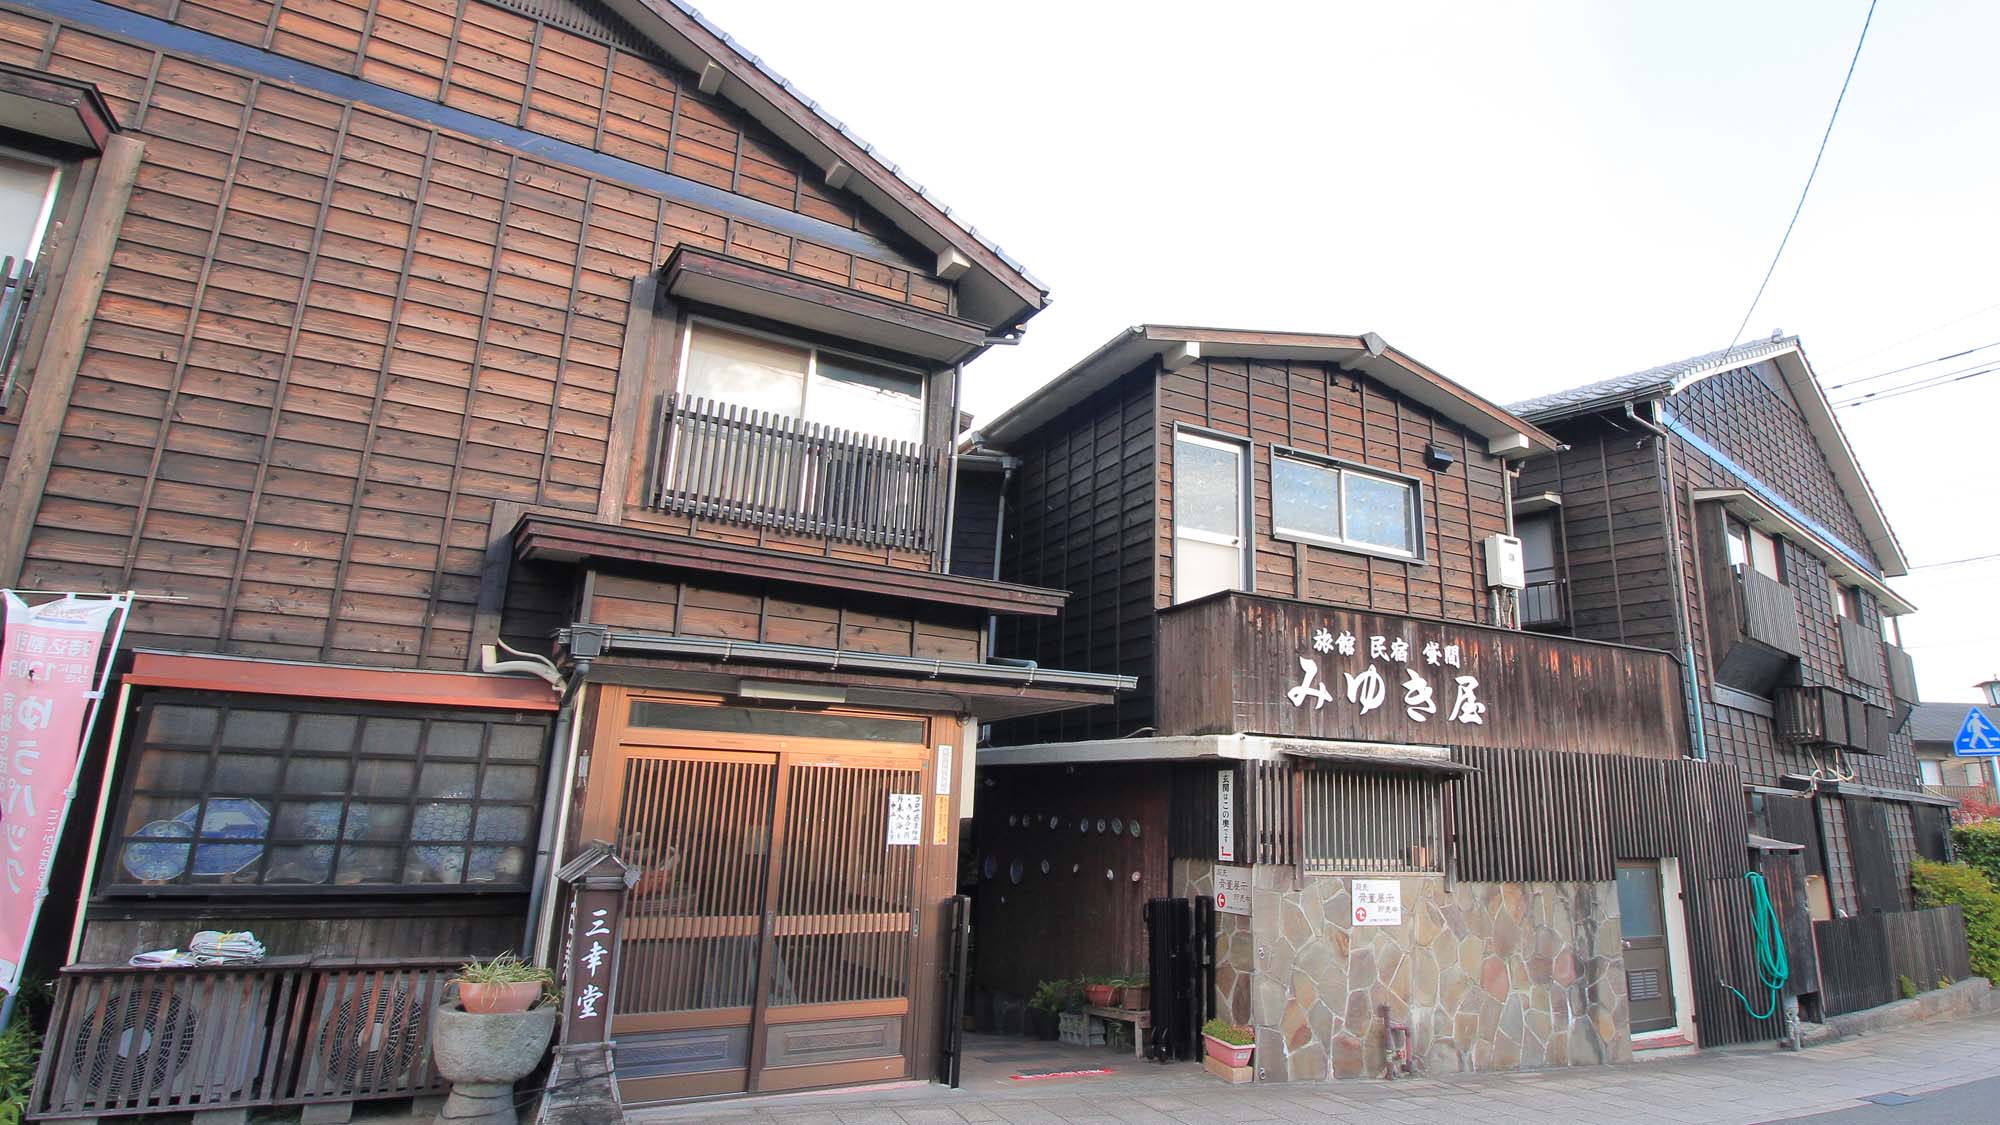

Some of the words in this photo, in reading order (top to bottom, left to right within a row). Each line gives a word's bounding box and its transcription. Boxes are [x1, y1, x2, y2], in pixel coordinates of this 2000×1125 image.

[1312, 627, 1357, 657] 旅館
[1370, 636, 1409, 664] 民宿
[1287, 656, 1487, 725] みゆき屋
[1219, 878, 1249, 893] 骨董展示
[1358, 892, 1396, 904] 骨董展示
[577, 909, 611, 1020] 三幸堂
